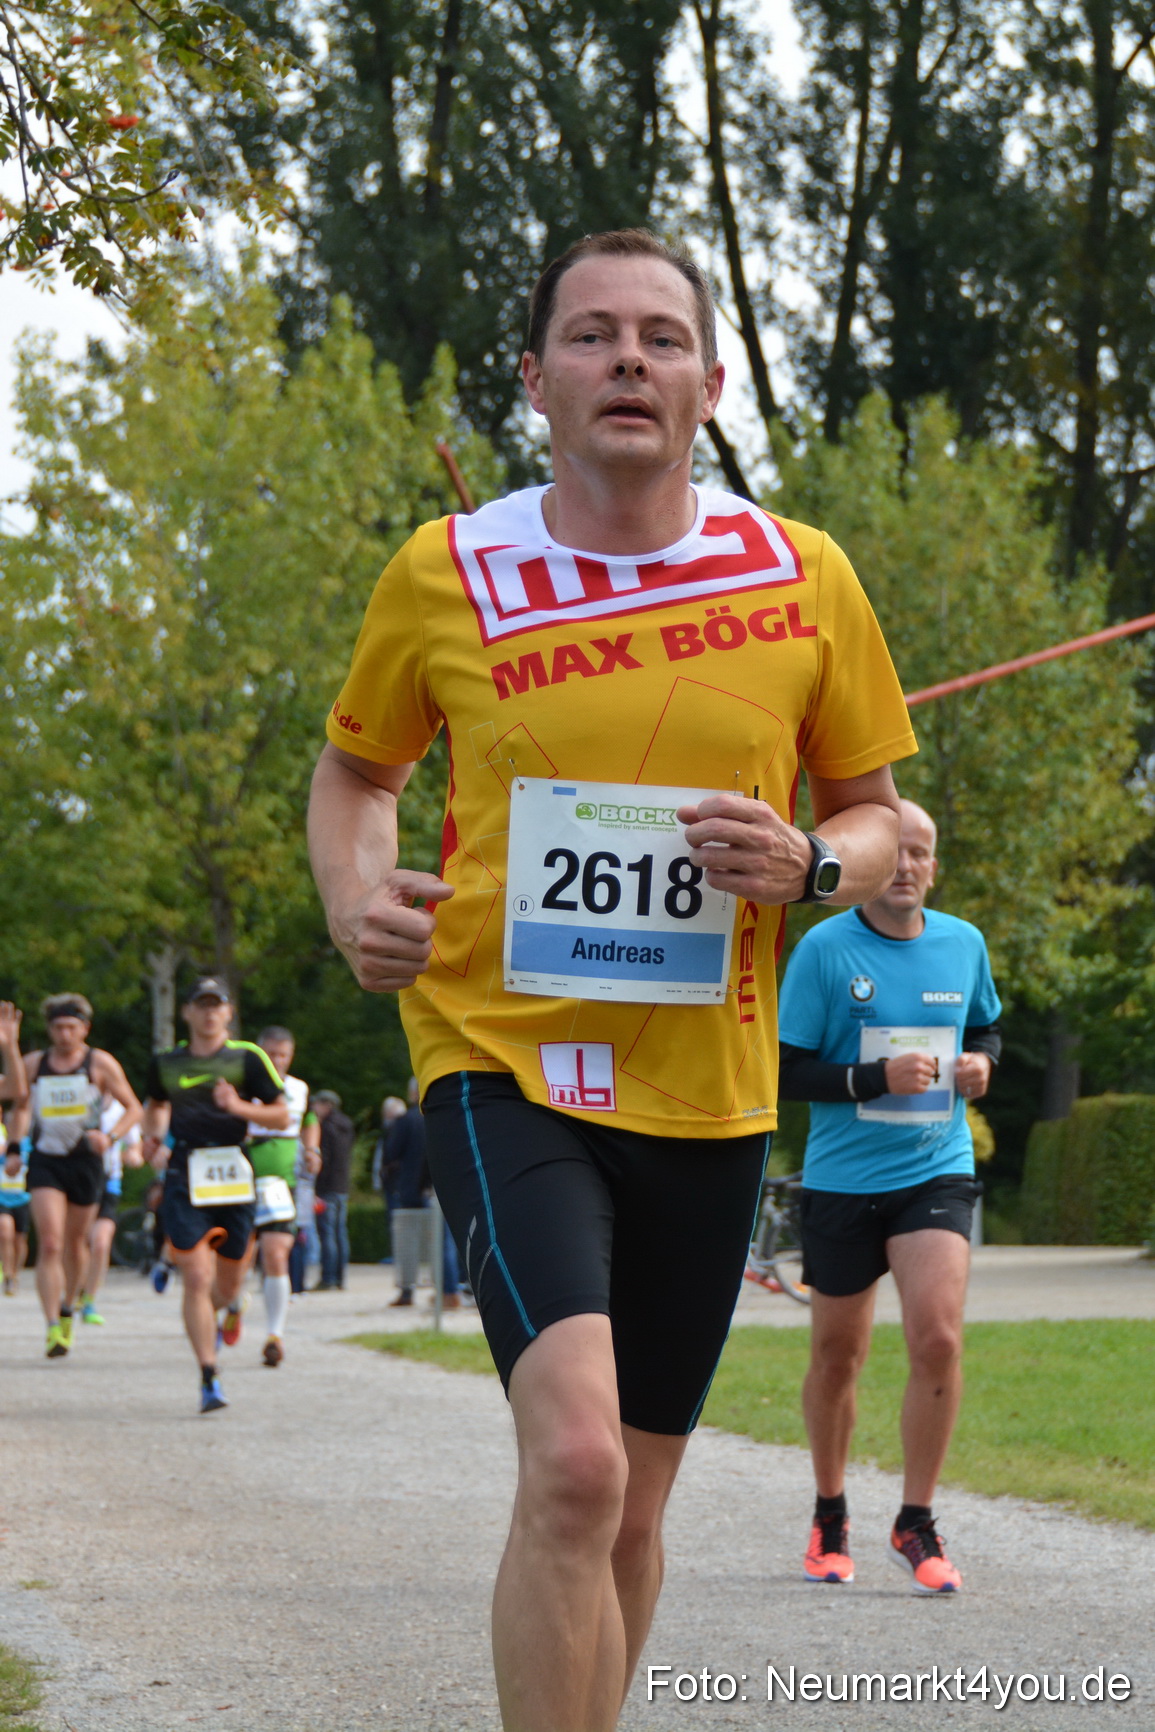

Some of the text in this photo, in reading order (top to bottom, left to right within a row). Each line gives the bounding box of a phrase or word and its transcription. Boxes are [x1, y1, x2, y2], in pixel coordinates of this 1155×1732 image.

[490, 602, 818, 701] MAX BÖGL
[598, 804, 677, 826] BOCK
[541, 847, 704, 920] 2618
[519, 899, 528, 912] D
[571, 937, 665, 965] Andreas
[921, 991, 964, 1003] BOCK
[205, 1164, 237, 1181] 414
